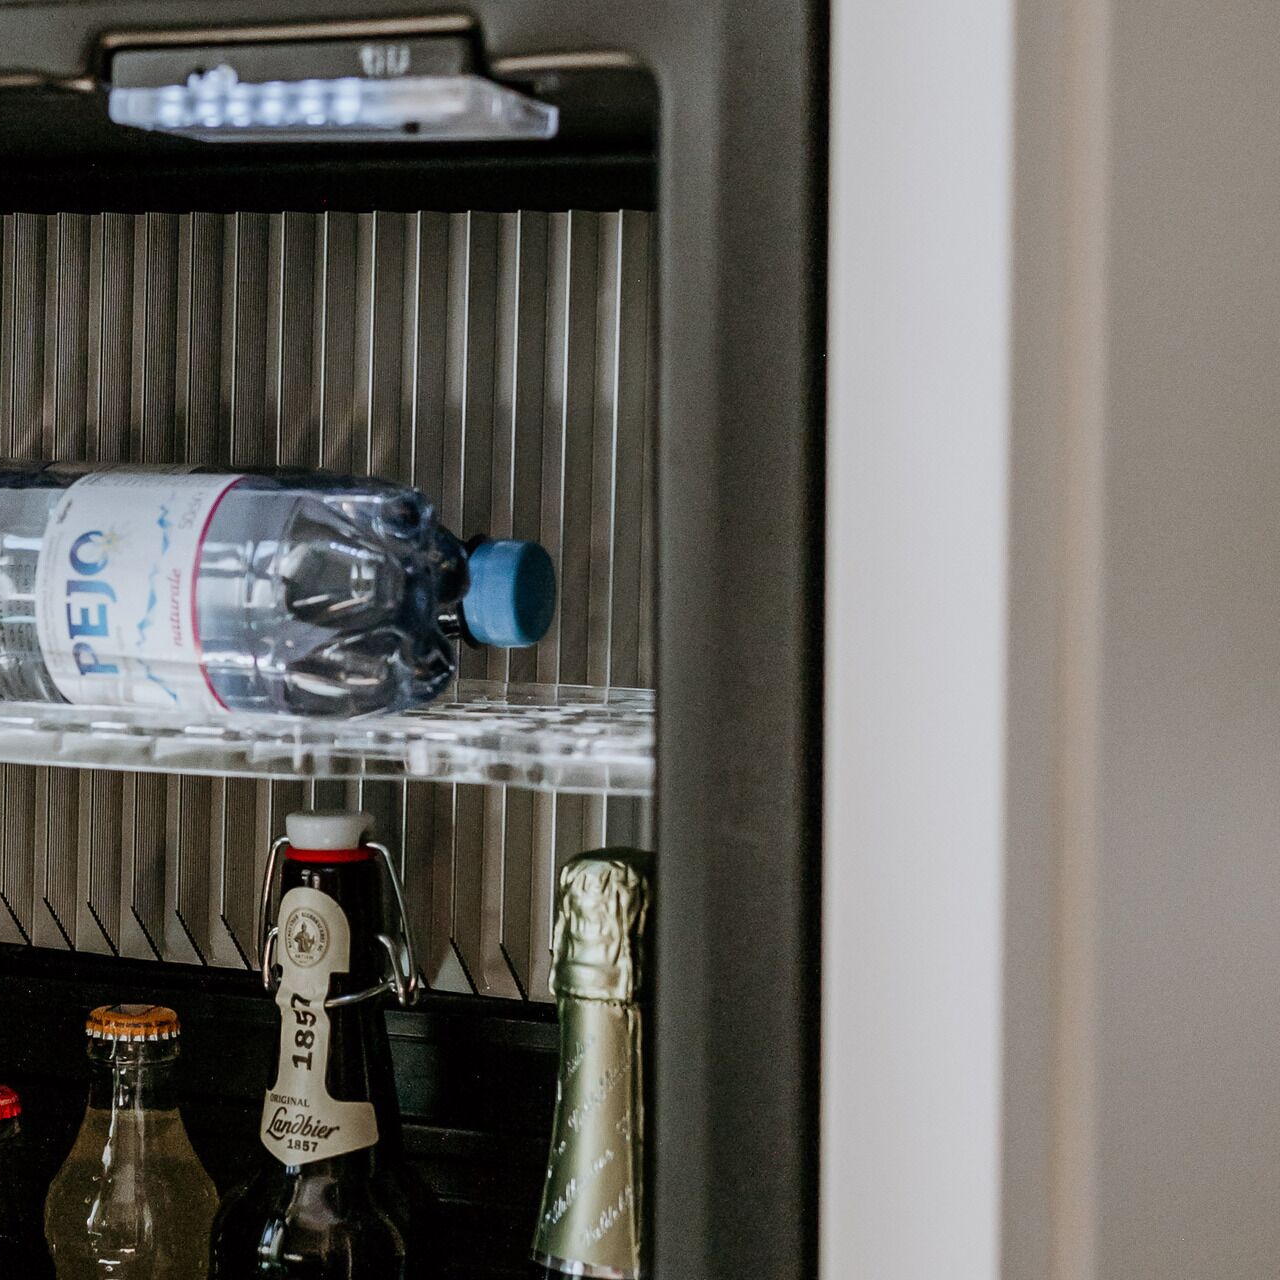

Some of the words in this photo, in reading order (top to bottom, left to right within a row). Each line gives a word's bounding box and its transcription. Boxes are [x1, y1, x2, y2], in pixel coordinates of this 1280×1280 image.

[66, 529, 120, 677] PEJO
[291, 992, 318, 1072] 1857
[269, 1093, 310, 1108] ORIGINAL
[266, 1106, 340, 1140] Landbier
[287, 1138, 319, 1152] 1857
